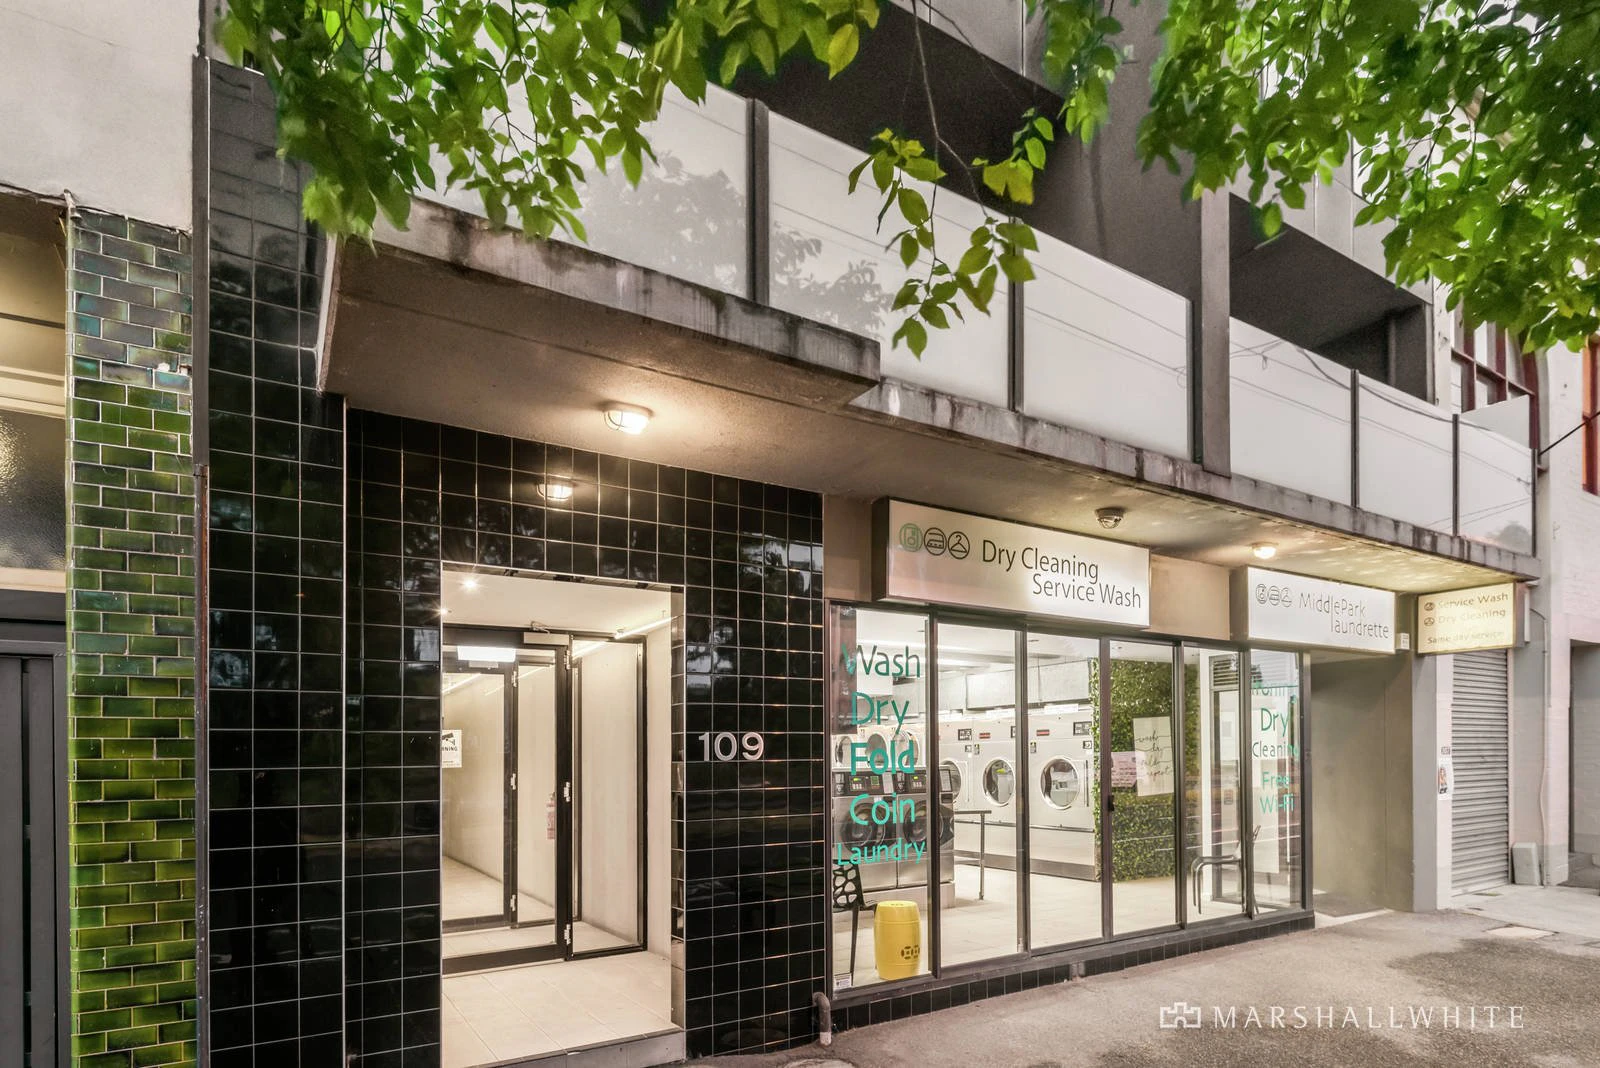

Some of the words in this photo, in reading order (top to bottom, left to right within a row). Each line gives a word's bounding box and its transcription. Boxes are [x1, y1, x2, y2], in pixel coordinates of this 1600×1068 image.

[983, 539, 1016, 572] Dry
[1021, 547, 1099, 585] Cleaning
[1032, 573, 1095, 602] Service
[1099, 582, 1142, 609] Wash
[1438, 598, 1474, 610] Service
[1477, 592, 1509, 604] Wash
[842, 644, 921, 678] Wash
[851, 691, 910, 735] Dry
[1261, 708, 1289, 738] Dry
[698, 731, 764, 762] 109
[850, 739, 915, 776] Fold
[1262, 771, 1290, 791] Free
[849, 792, 916, 826] Coin
[1259, 794, 1296, 816] Wi-Fi
[836, 838, 926, 866] Laundry
